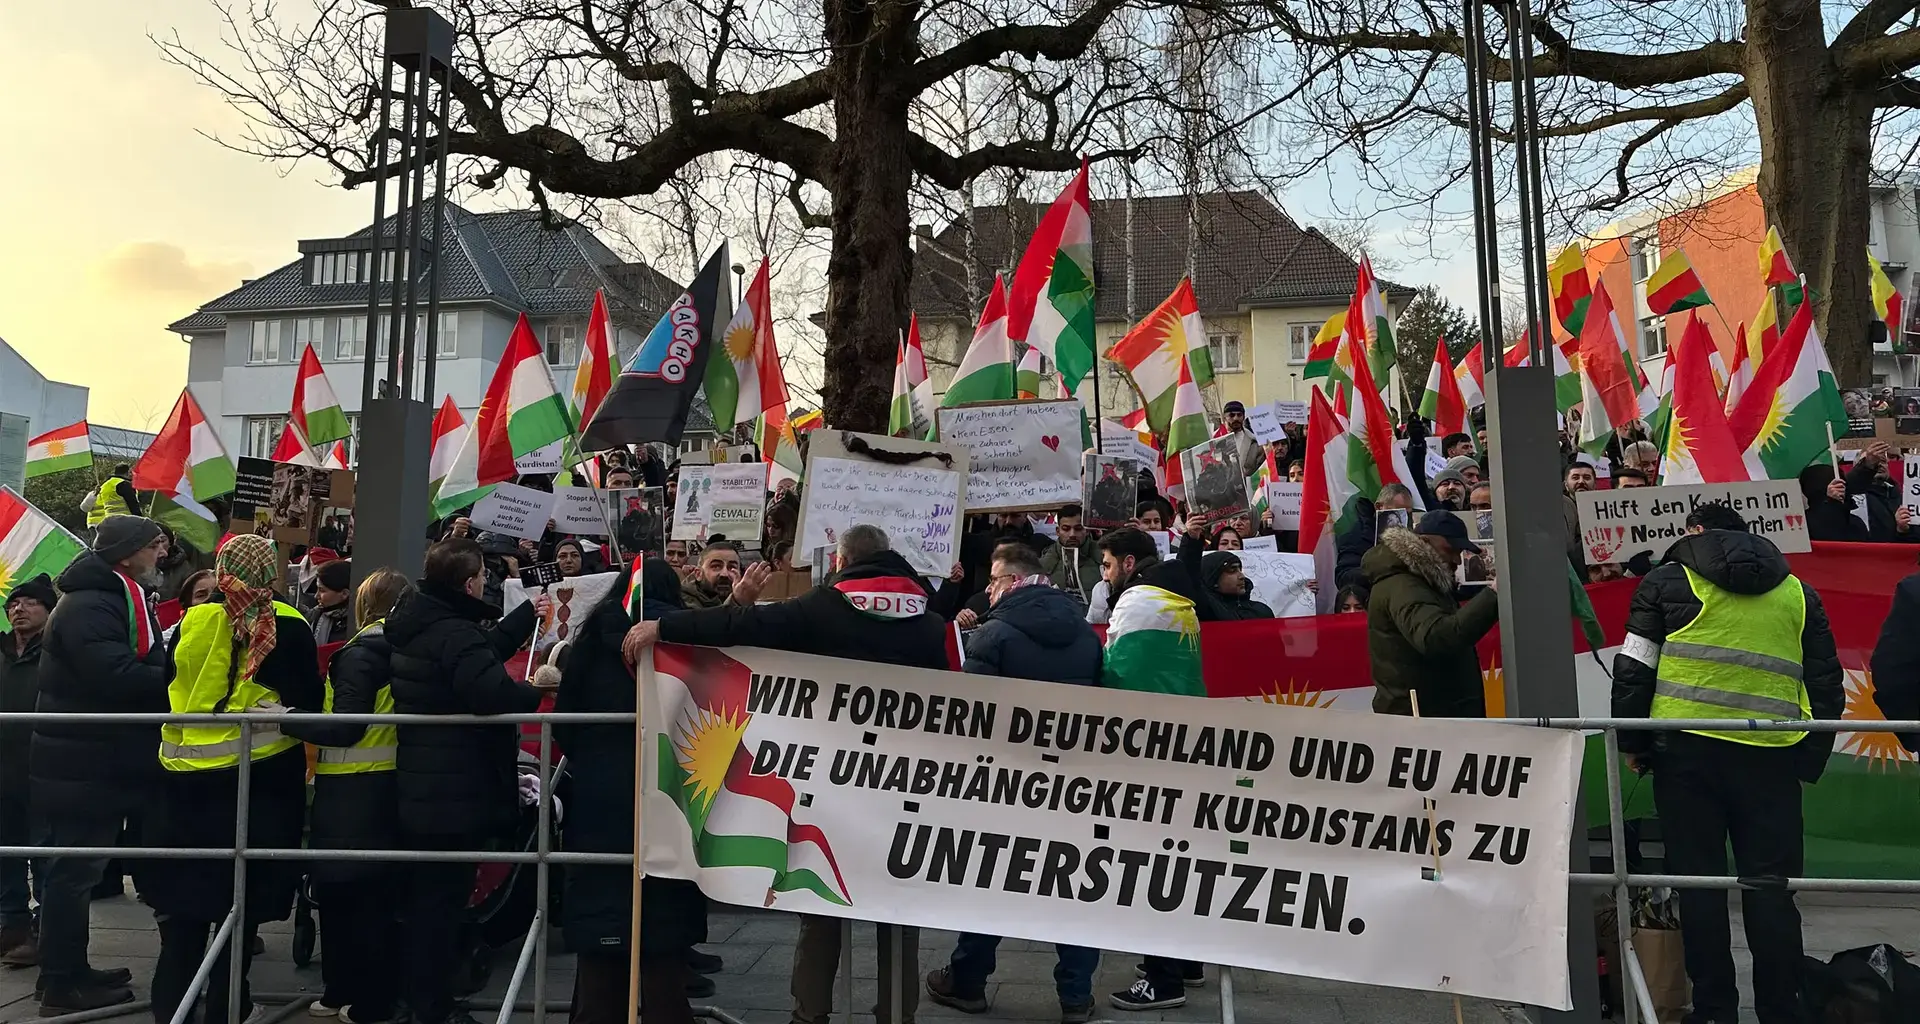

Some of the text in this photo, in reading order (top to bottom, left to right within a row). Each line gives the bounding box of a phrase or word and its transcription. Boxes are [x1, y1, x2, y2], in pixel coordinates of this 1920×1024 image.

[955, 409, 998, 424] Menschen
[515, 460, 558, 468] Kurdistan!
[493, 491, 533, 508] Demokratie
[566, 494, 588, 502] Stoppt
[499, 504, 529, 516] unteilbar
[931, 504, 954, 518] JIN
[1594, 491, 1789, 520] Hilft den Krden im
[497, 512, 525, 524] auch für
[566, 515, 602, 523] Repression
[713, 508, 760, 519] GEWALT?
[491, 520, 524, 532] Kurdistan
[1631, 523, 1686, 544] Nordo
[920, 540, 950, 554] AZADI
[747, 673, 1532, 799] WIR FORDERN DEUTSCHLAND UND EU AUF
[750, 739, 1531, 866] DIE UNABHÄNGIGKEIT KURDISTANS ZU
[886, 821, 1366, 936] UNTERSTÜTZEN.
